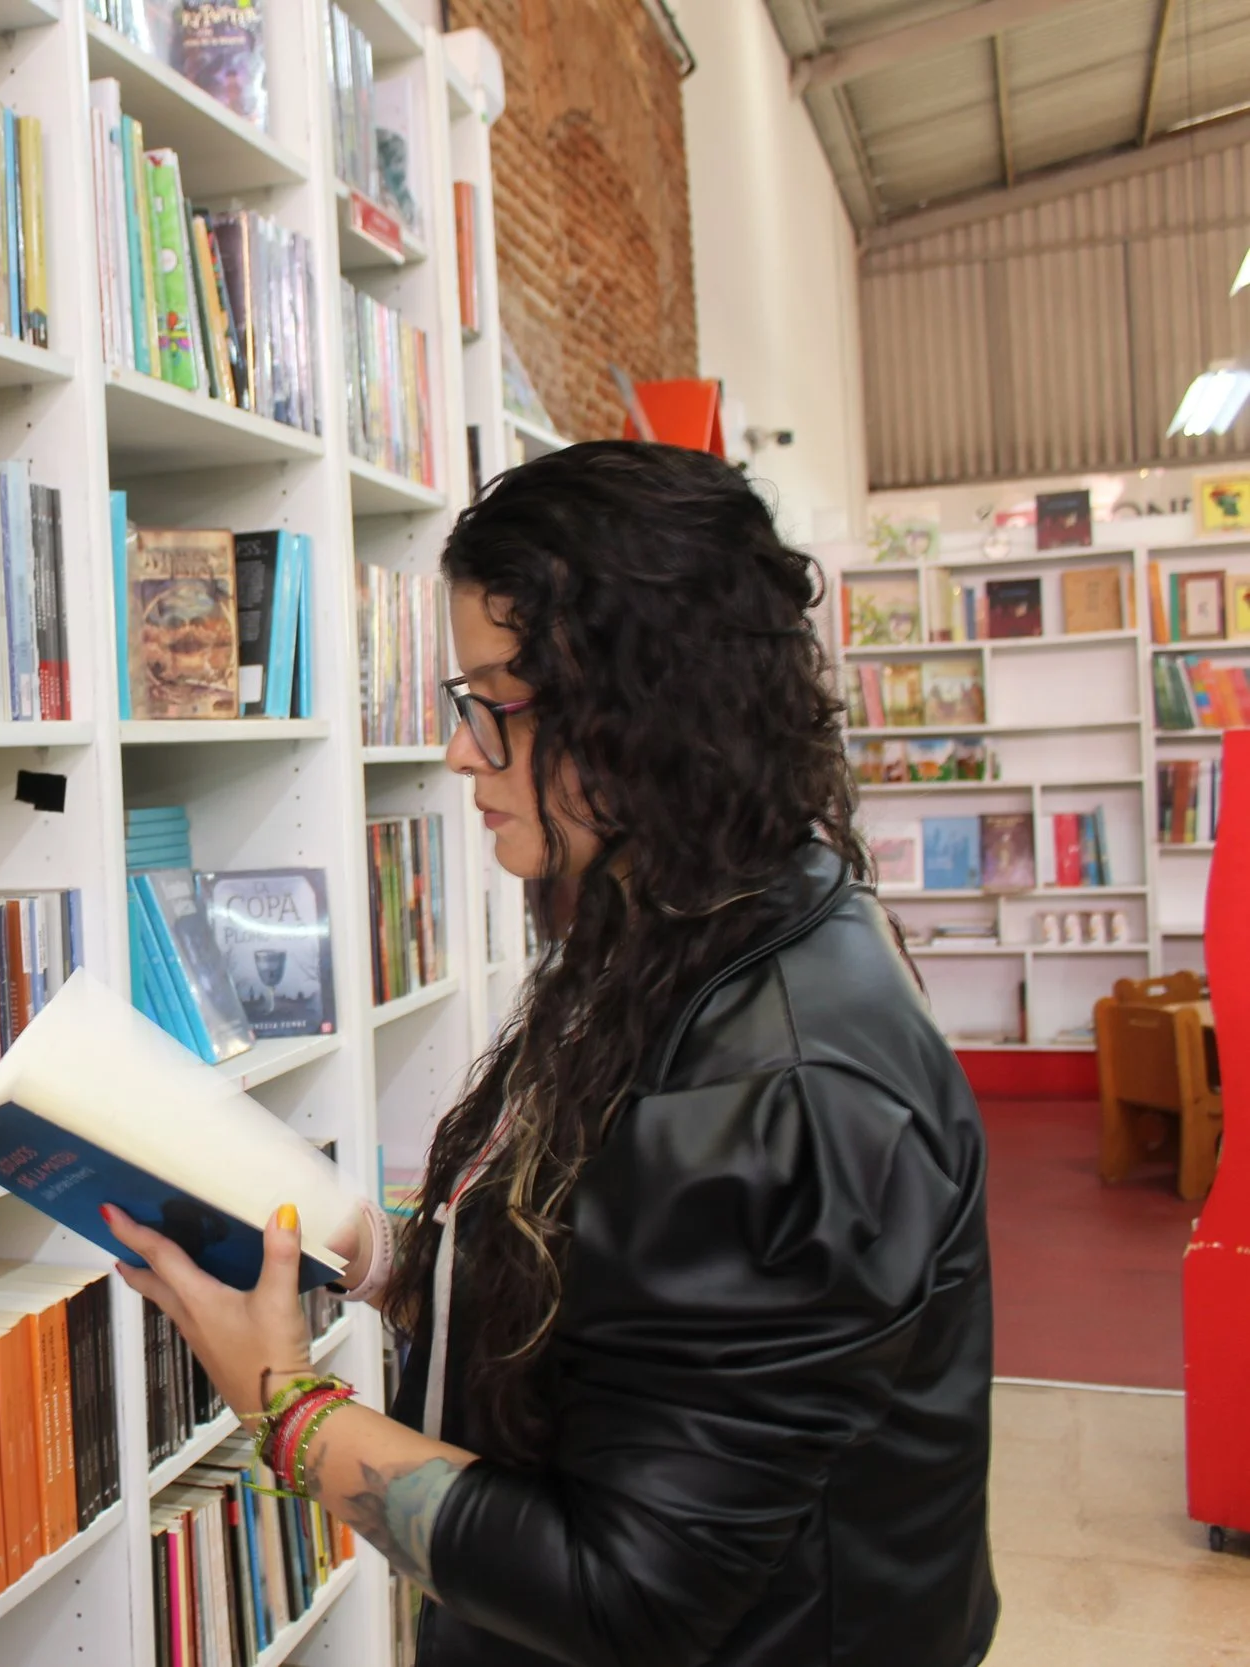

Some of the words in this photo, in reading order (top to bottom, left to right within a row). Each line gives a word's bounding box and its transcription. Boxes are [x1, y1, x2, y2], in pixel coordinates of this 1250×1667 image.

[226, 892, 301, 922] COPA
[44, 1402, 52, 1445] Cardenal
[45, 1447, 54, 1483] Ernesto
